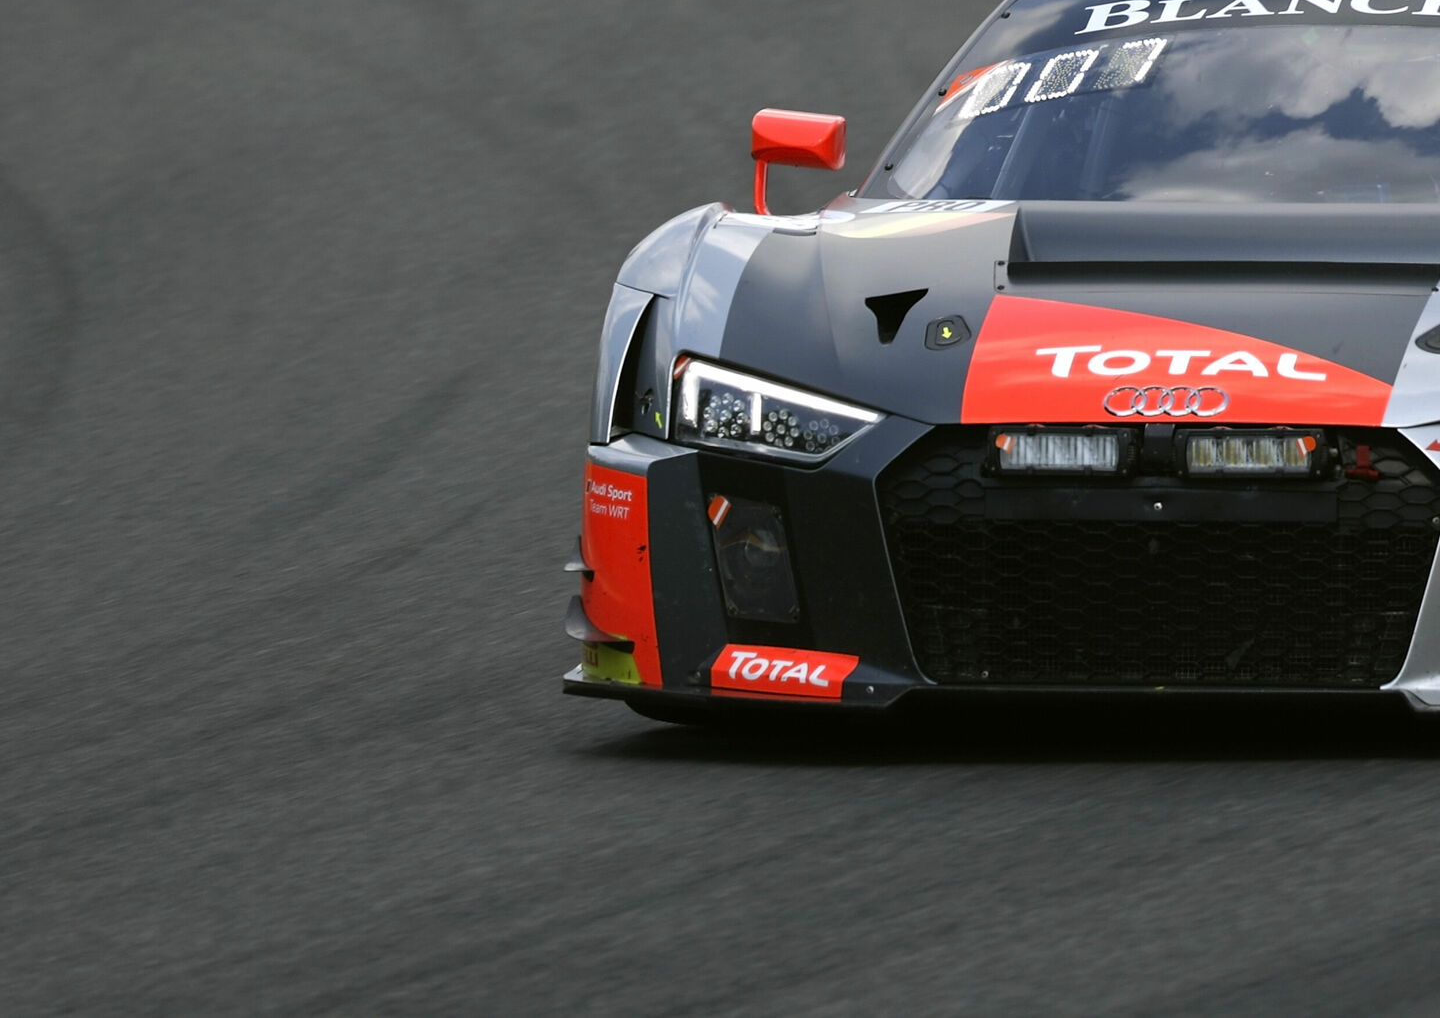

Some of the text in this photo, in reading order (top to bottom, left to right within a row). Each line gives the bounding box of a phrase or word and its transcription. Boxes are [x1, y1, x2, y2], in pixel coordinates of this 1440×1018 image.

[888, 200, 986, 212] PRO
[1036, 344, 1328, 381] TOTAL
[592, 481, 632, 501] Audi Sport
[590, 499, 629, 519] Team WRT
[728, 651, 829, 687] TOTAL
